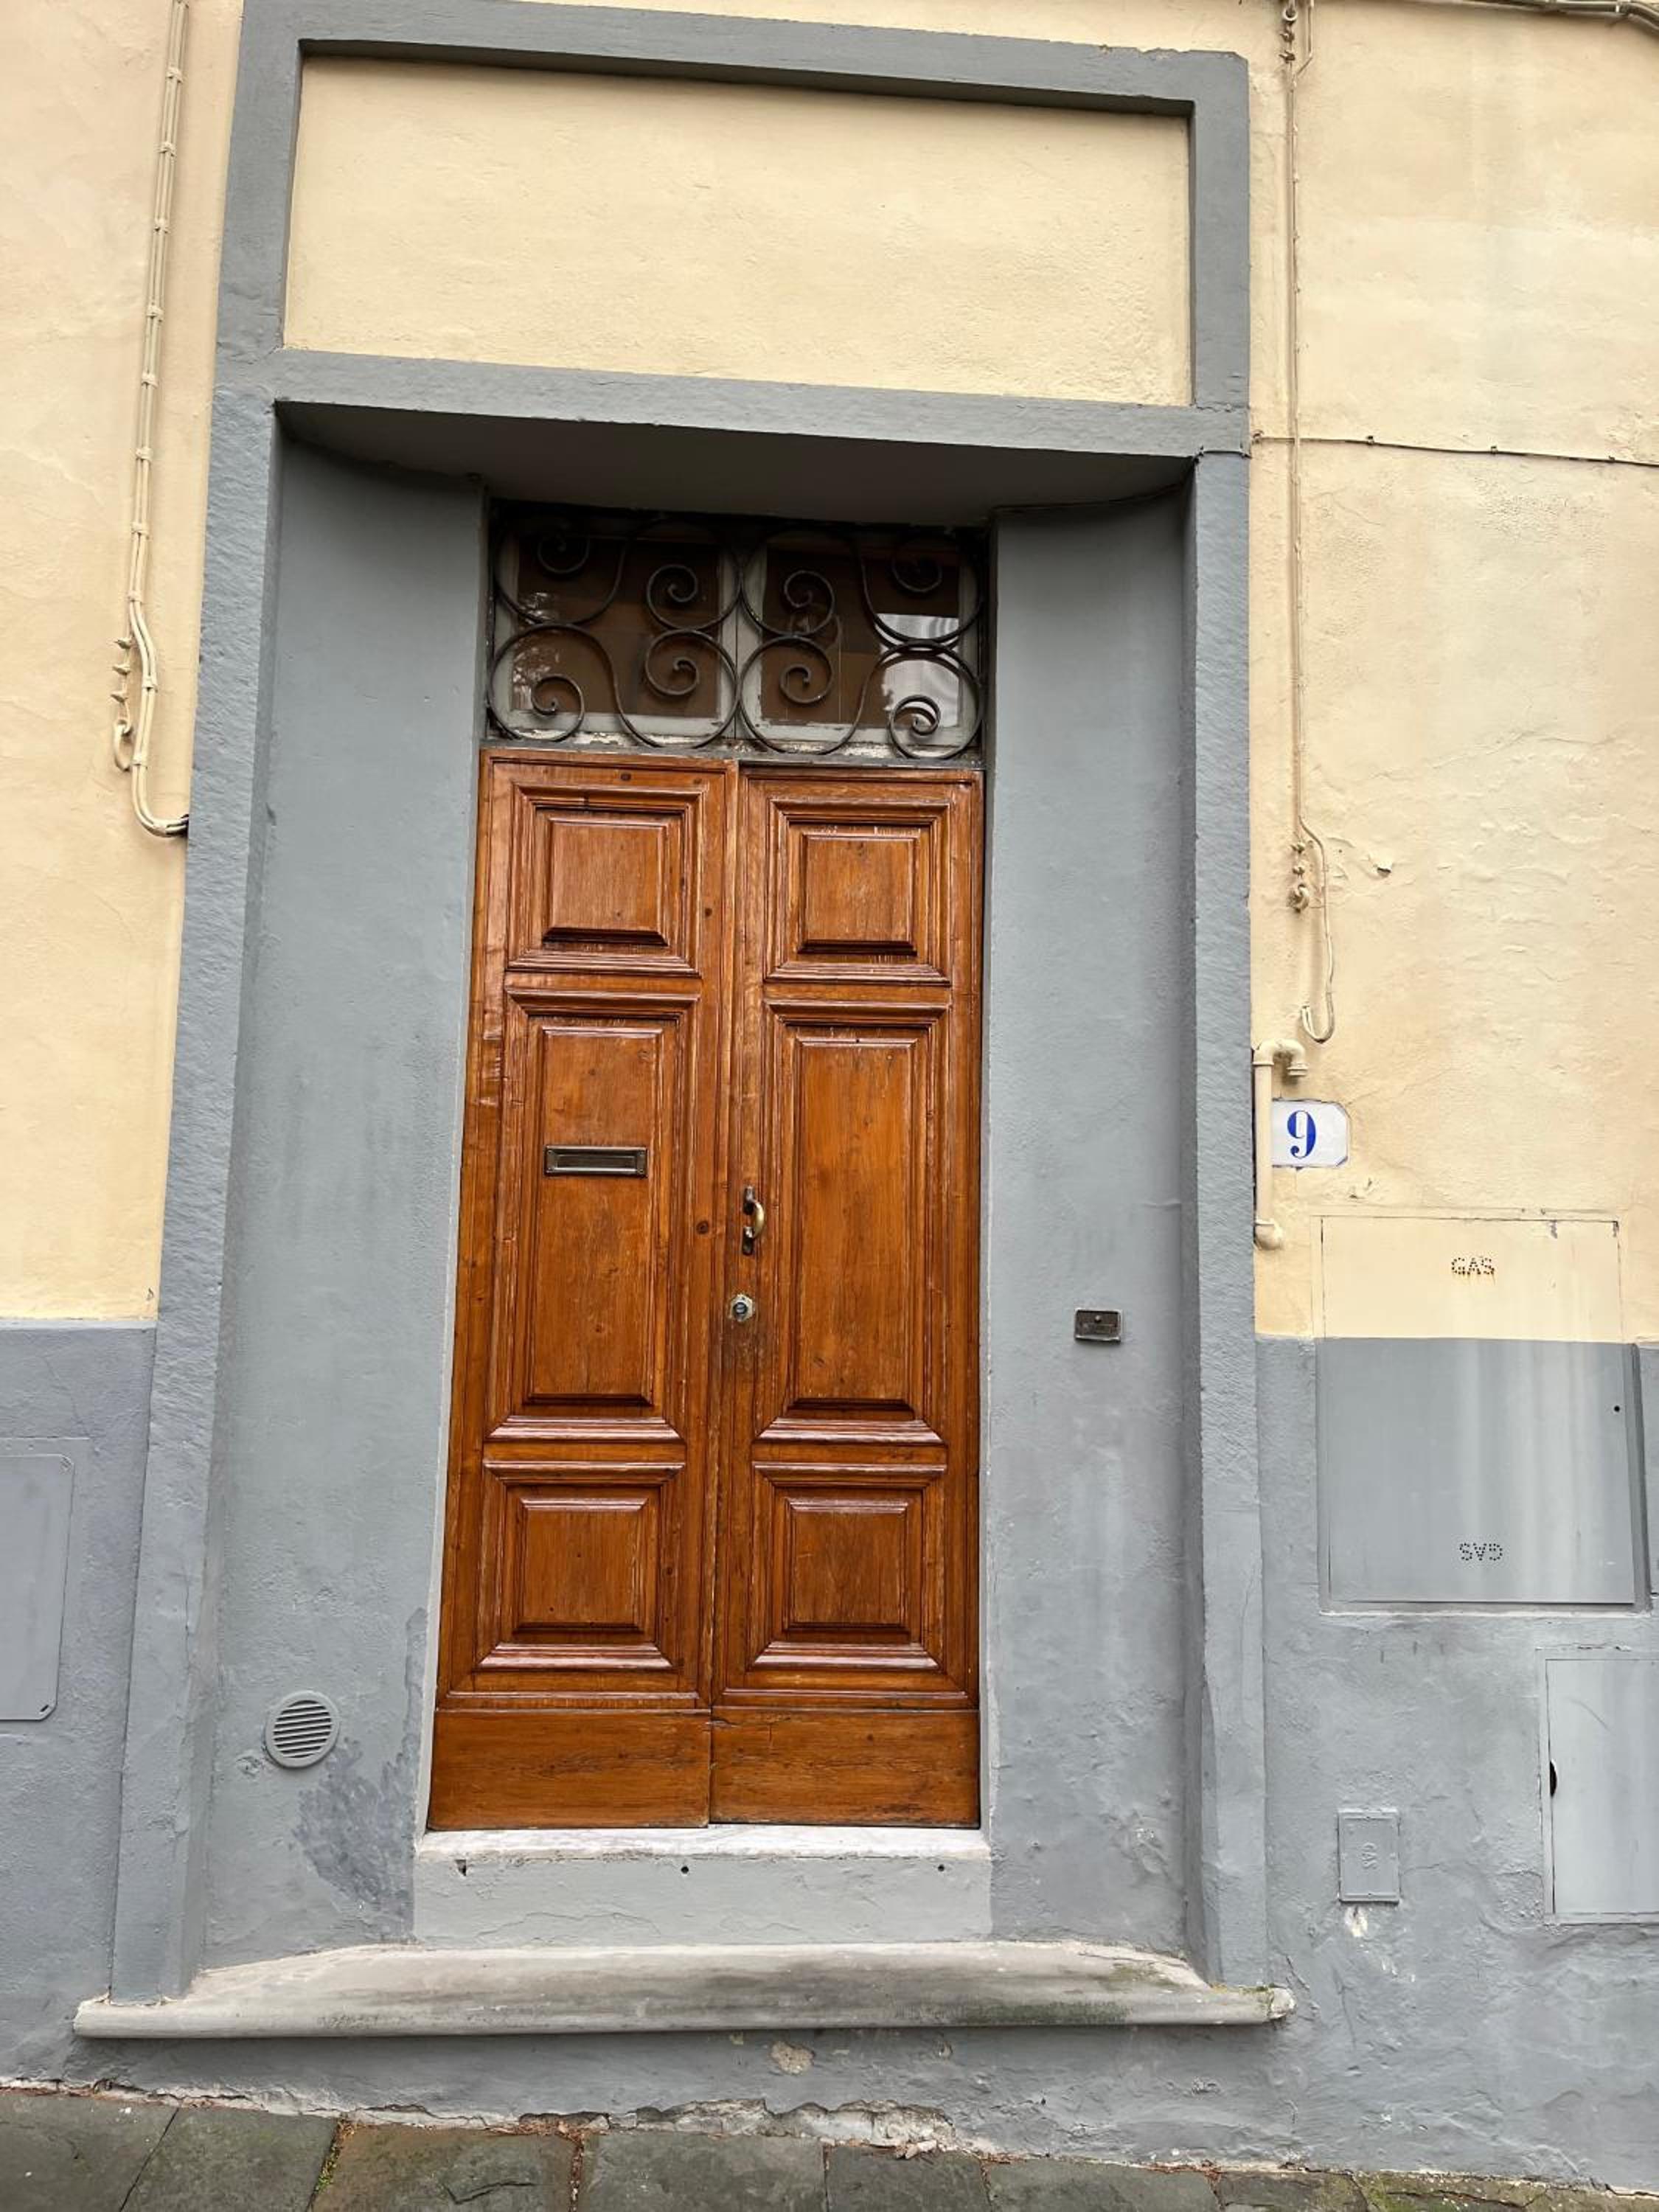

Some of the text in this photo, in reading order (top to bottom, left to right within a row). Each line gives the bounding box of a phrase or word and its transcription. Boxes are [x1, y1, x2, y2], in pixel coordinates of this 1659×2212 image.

[1287, 1110, 1316, 1159] 9
[1451, 1256, 1495, 1275] GAS
[1362, 1842, 1378, 1870] GAS
